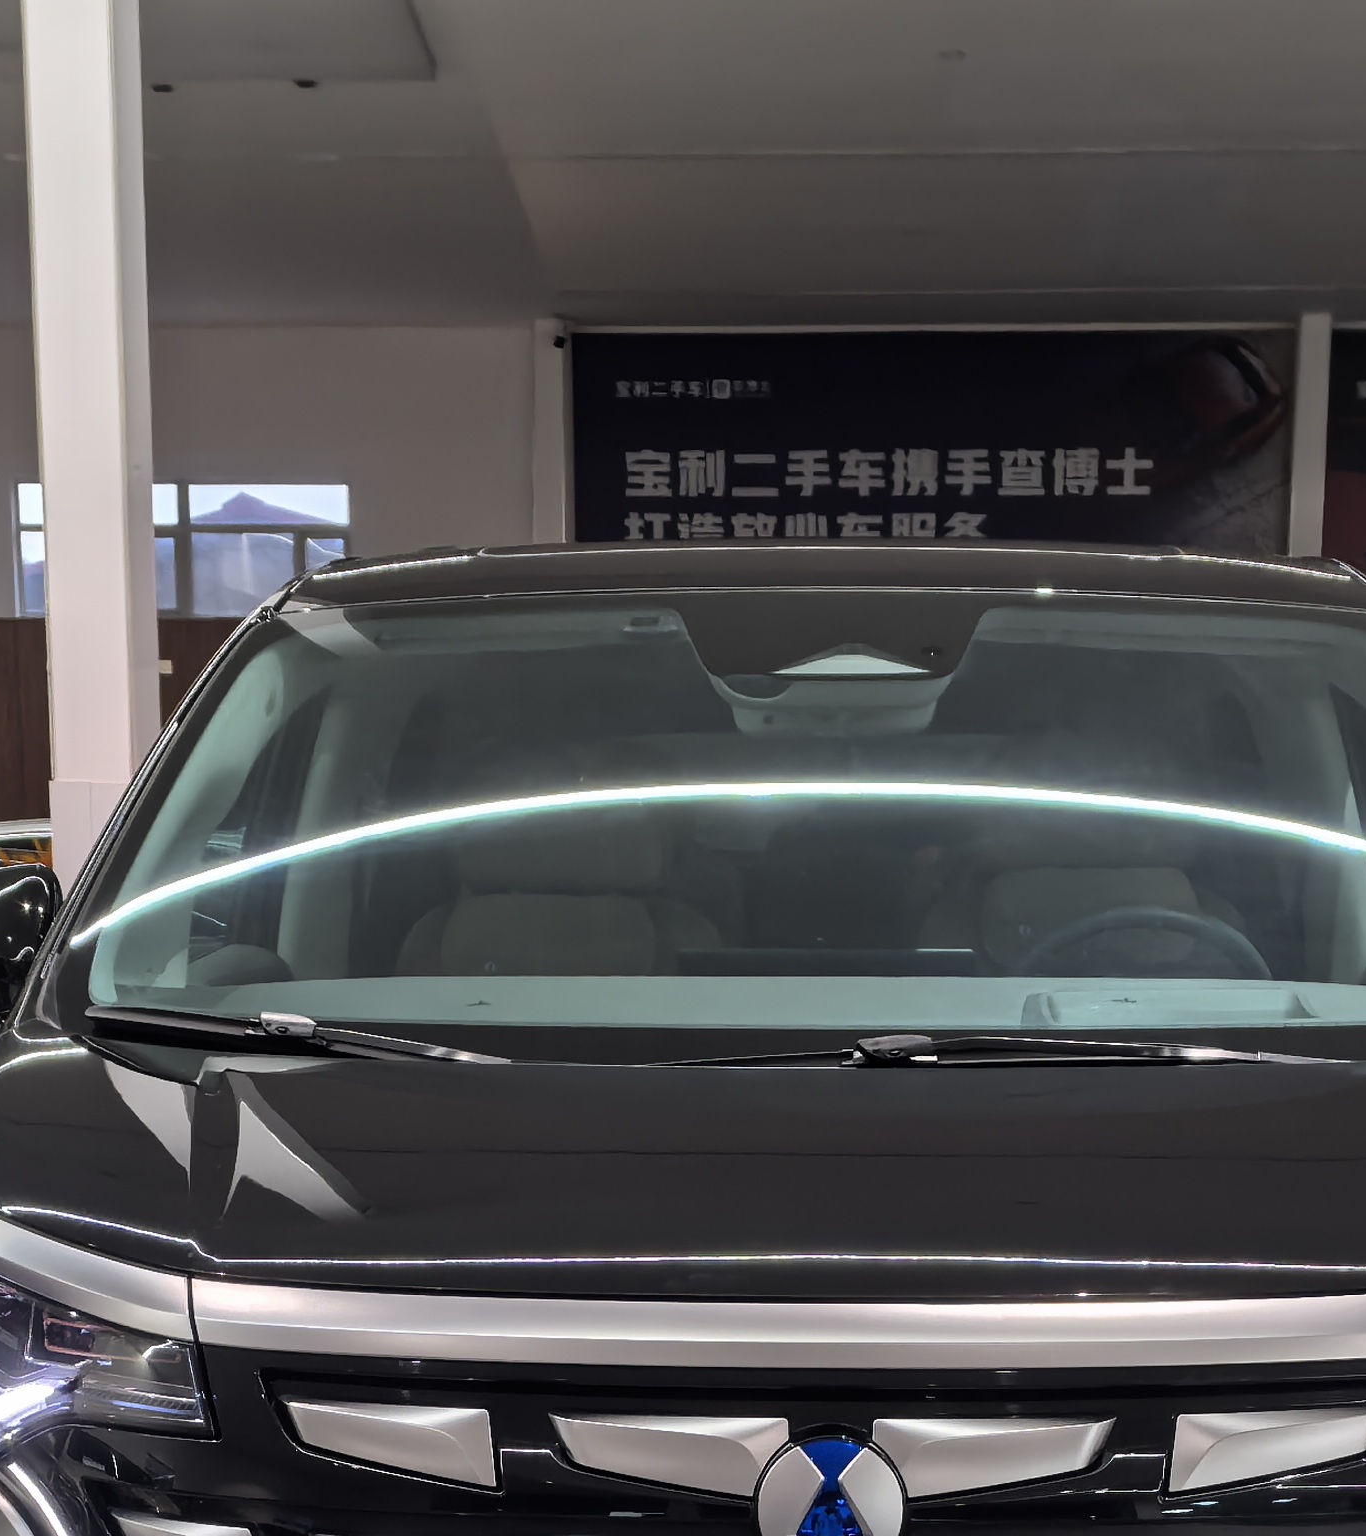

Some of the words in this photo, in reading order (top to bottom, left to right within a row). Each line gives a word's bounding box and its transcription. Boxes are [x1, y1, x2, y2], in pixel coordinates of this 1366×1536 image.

[624, 447, 1154, 498] 宝利二手车携手查博士
